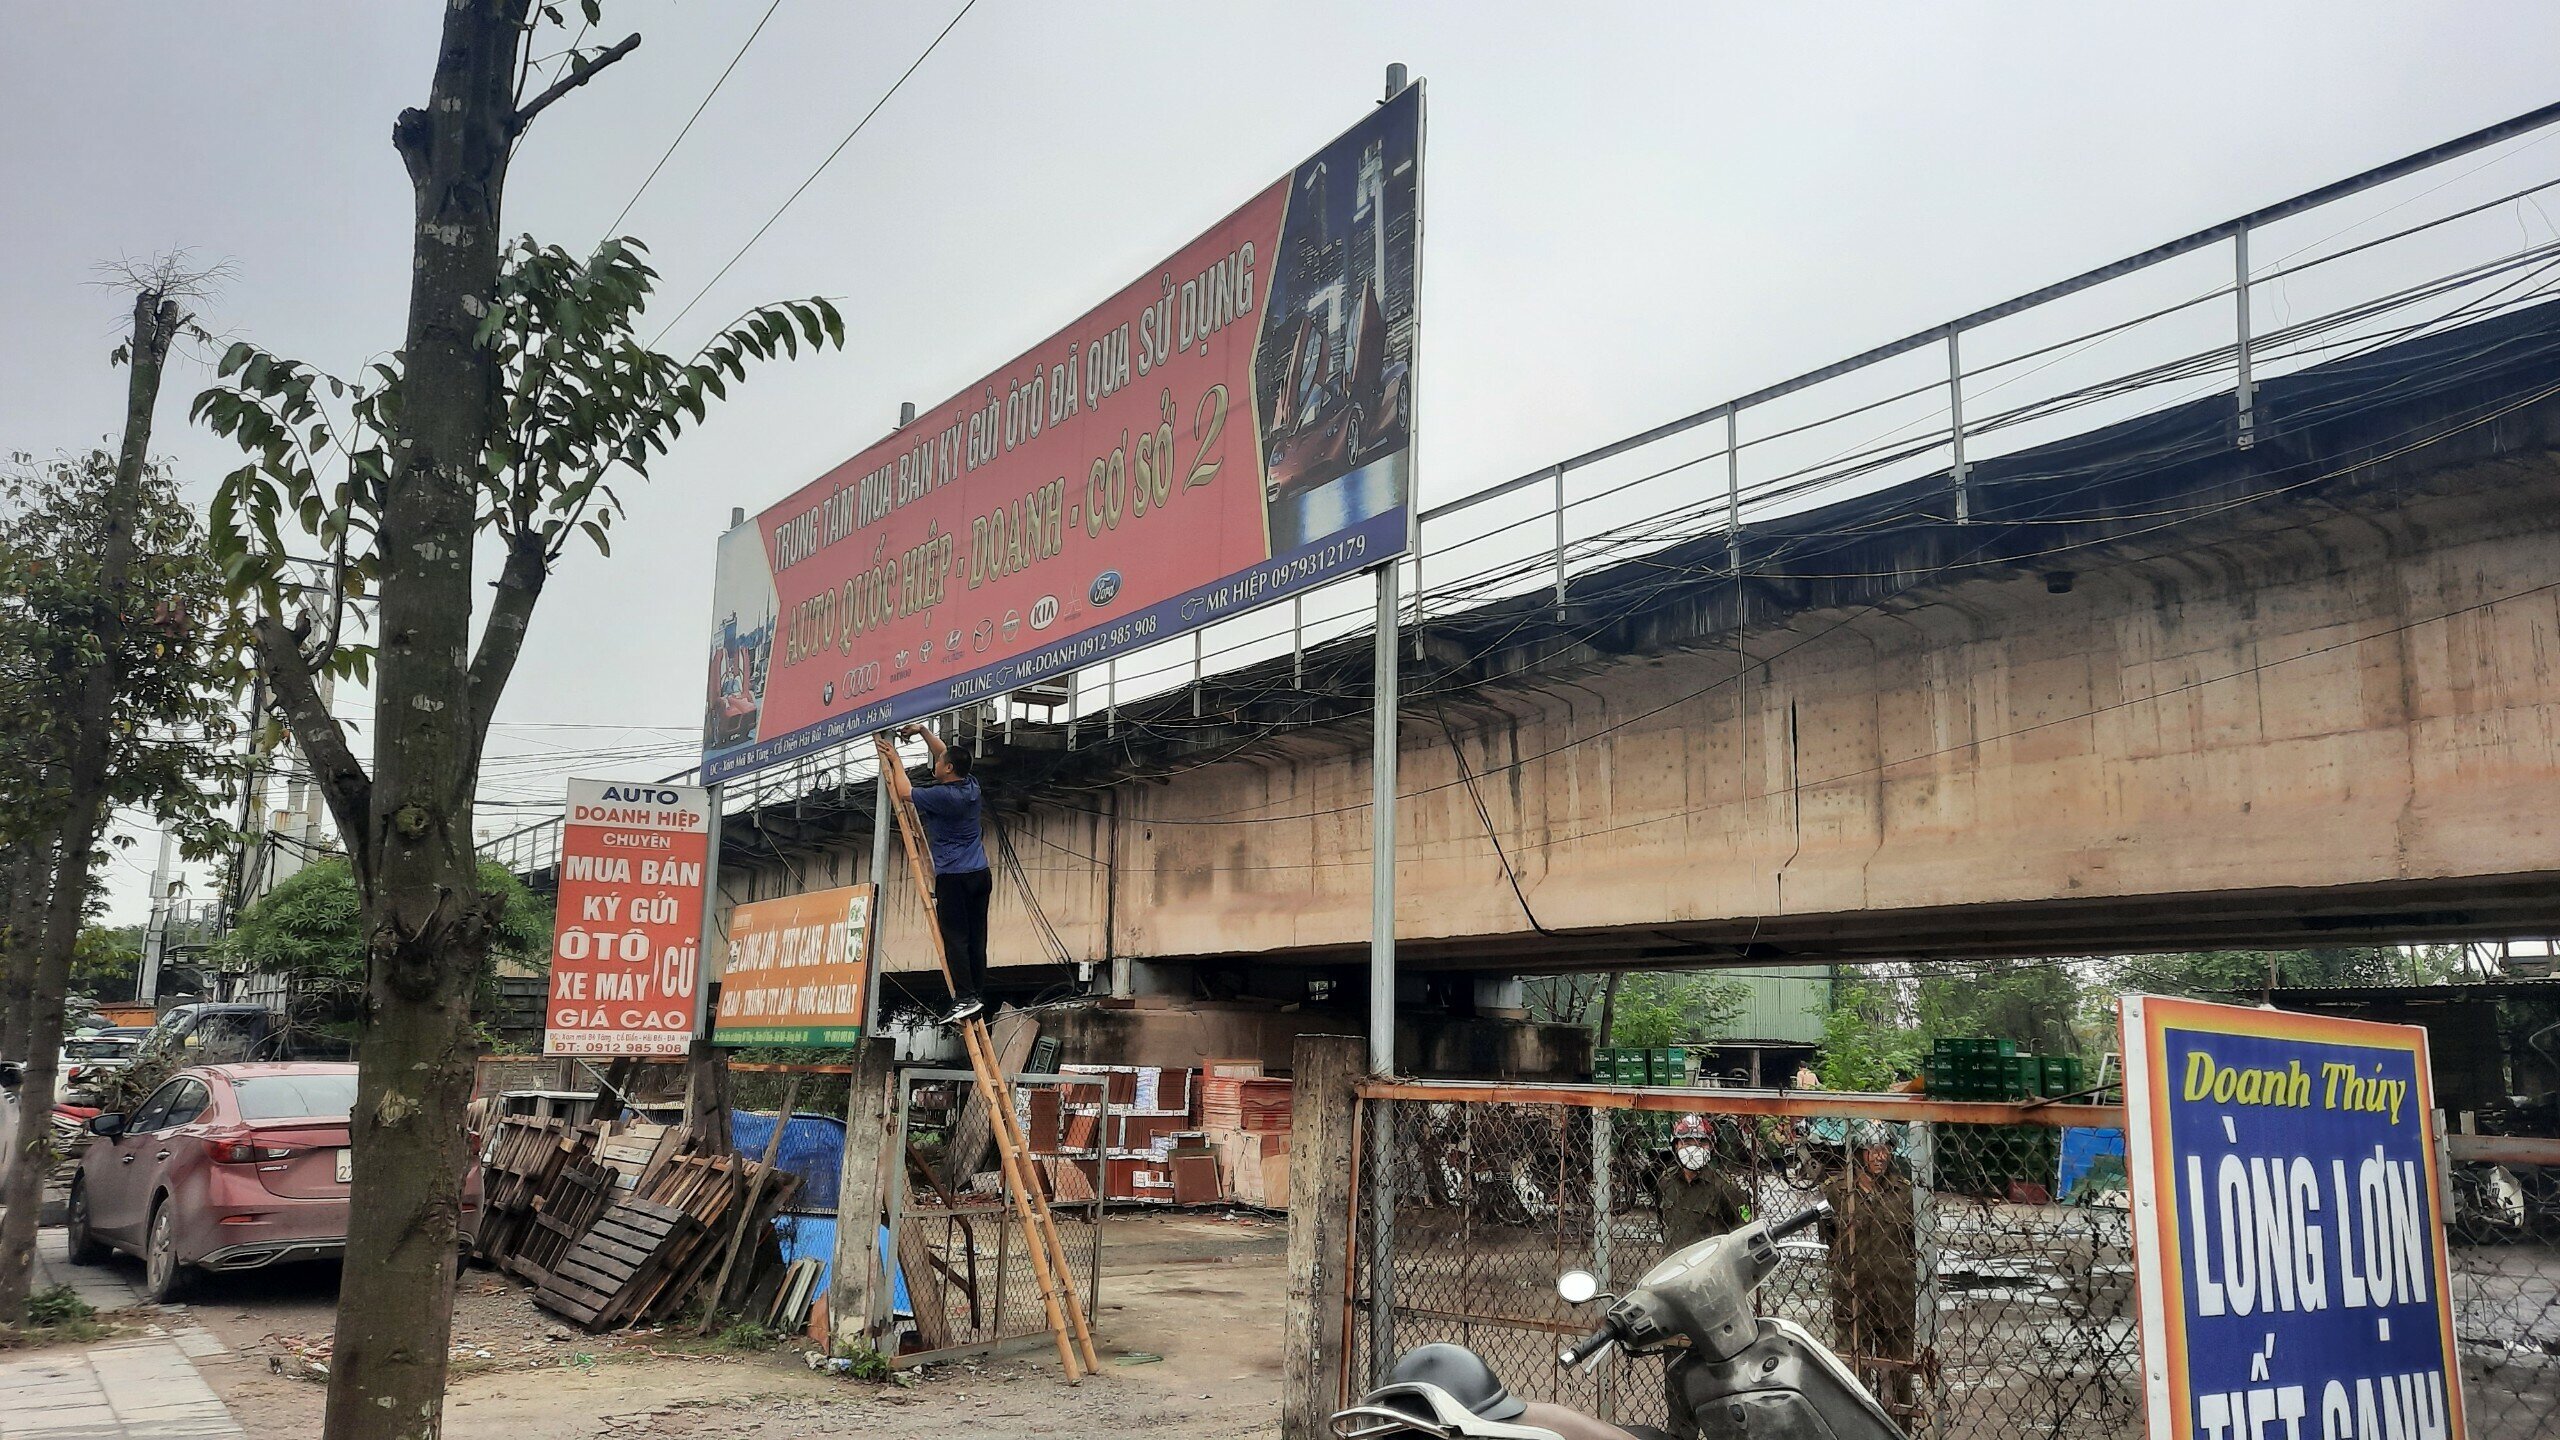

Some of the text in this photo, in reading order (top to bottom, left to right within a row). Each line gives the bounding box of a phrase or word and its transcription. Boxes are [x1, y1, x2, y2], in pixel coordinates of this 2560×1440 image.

[774, 240, 1256, 575] TRUNG TÂM MUA BÁN KÝ GỬI ÔTÔ ĐÃ QUA SỬ DỤNG
[783, 588, 837, 668] AUTO
[838, 532, 897, 656] QUỐC
[899, 517, 953, 629] HIỆP
[968, 477, 1065, 591] DOANH
[1085, 428, 1128, 539] CƠ
[1133, 387, 1177, 518] SỞ
[1181, 383, 1230, 496] 2
[1094, 576, 1116, 602] Ford
[949, 534, 1367, 700] HOTLINE MR-DOANH 0912 985 908 MR HIỆP 0979312179
[1033, 601, 1055, 626] KIA
[846, 714, 860, 729] Anh
[866, 709, 877, 725] Hà
[878, 702, 892, 722] Nội
[602, 786, 679, 805] AUTO
[575, 805, 700, 831] DOANH HIỆP
[603, 832, 671, 848] CHUYÊN
[565, 855, 701, 887] MUA BÁN
[583, 891, 679, 925] KÝ GỬI
[780, 907, 800, 968] TIẾT
[799, 924, 824, 966] CANH
[559, 925, 696, 998] ÔTÔ CŨ
[555, 967, 650, 1001] XE MÁY
[796, 977, 818, 1015] NƯỚC
[817, 974, 836, 1015] GIẢI
[834, 974, 858, 1014] KHÁT
[555, 1004, 686, 1029] GIÁ CAO
[555, 1043, 682, 1053] ĐT: 0912 985 908
[2183, 1051, 2407, 1126] Doanh Thúy
[2186, 1115, 2427, 1342] LÒNG LỢN
